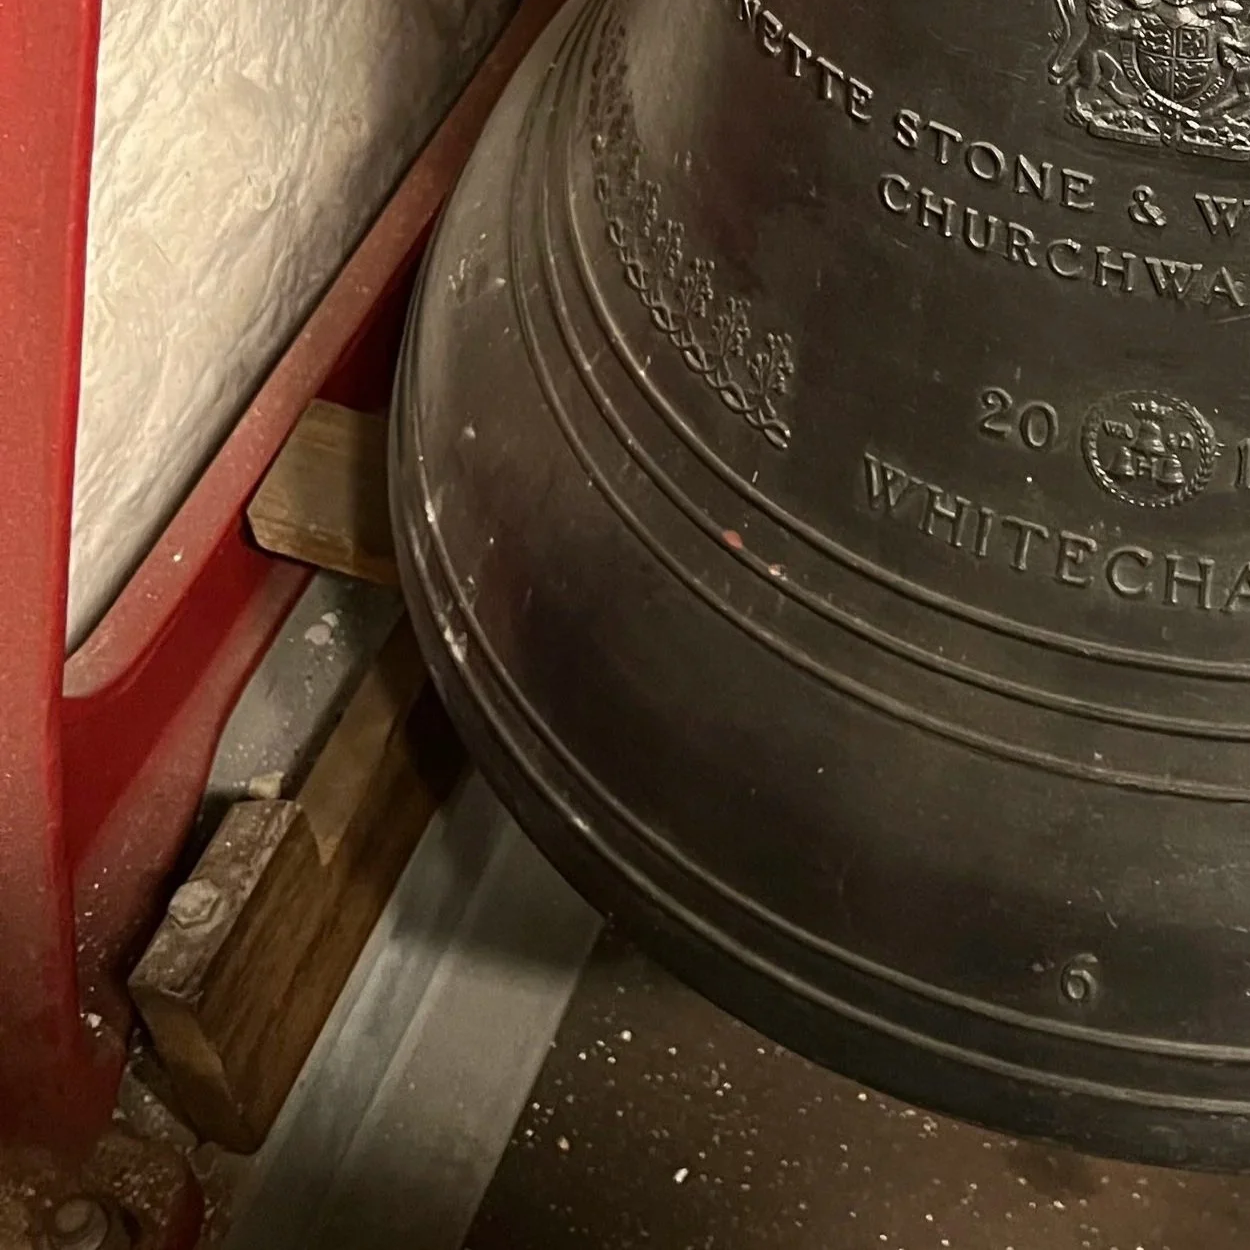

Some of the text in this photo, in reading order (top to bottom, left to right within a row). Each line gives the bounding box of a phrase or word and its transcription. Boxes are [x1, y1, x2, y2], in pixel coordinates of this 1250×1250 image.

[893, 109, 1096, 211] STONE
[1129, 184, 1169, 228] &
[979, 387, 1058, 449] 20
[1060, 953, 1099, 1002] 6
